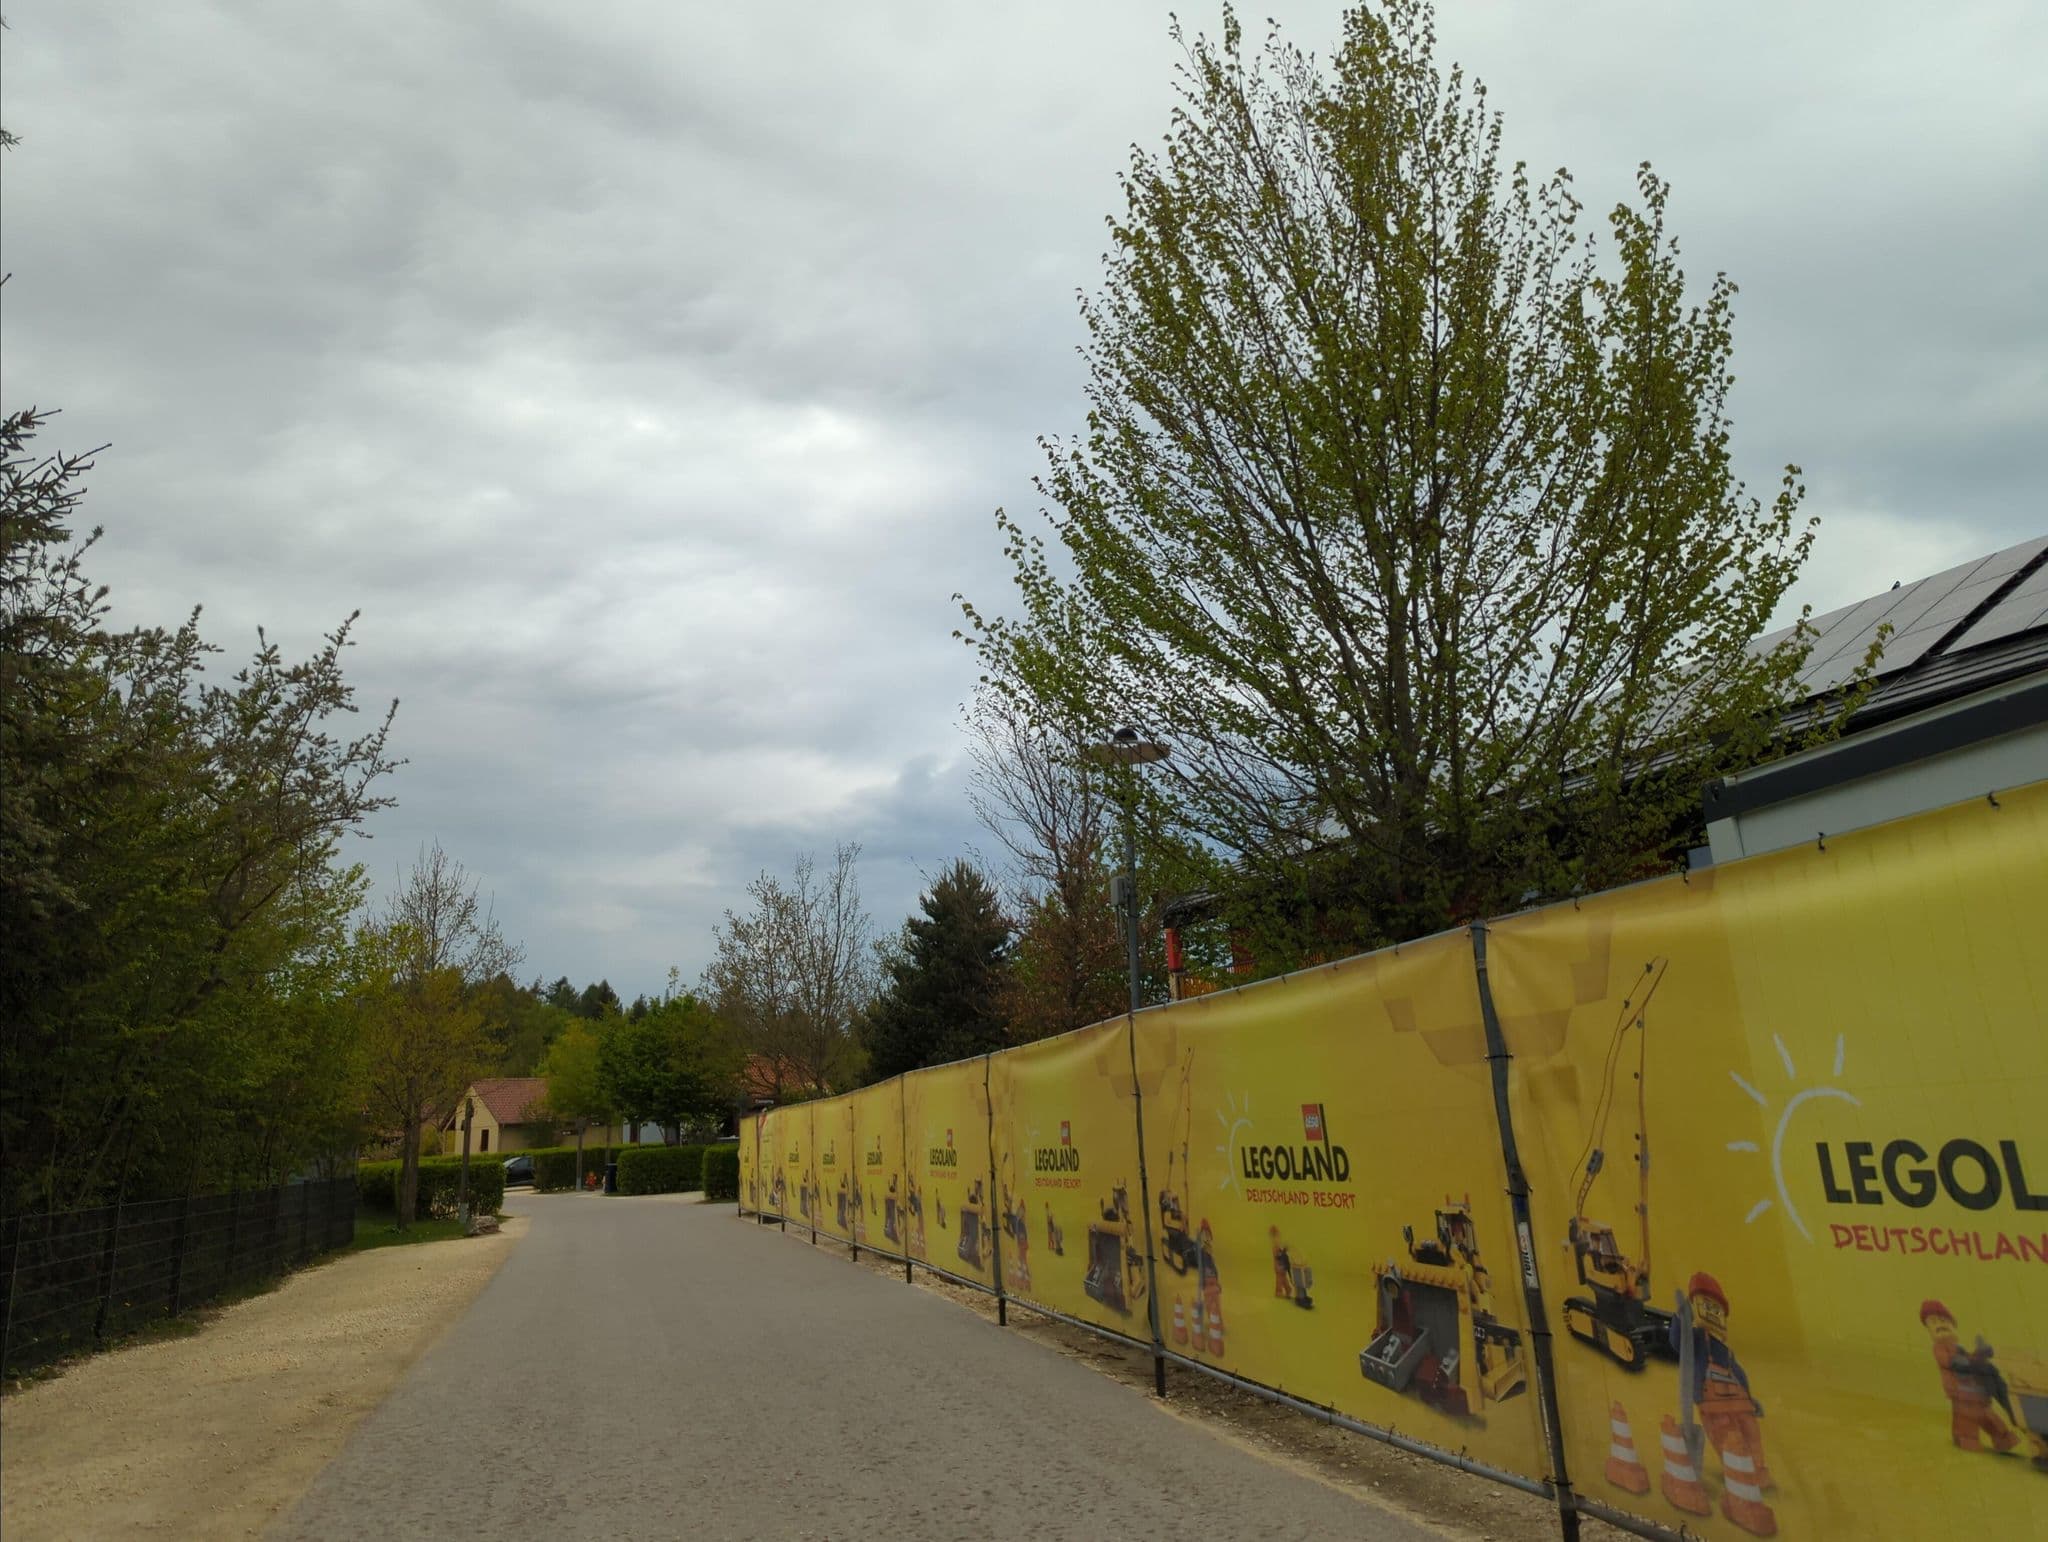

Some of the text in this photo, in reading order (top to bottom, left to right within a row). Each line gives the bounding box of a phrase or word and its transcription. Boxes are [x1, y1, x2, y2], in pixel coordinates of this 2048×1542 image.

[1034, 1146, 1080, 1172] LEGOLAND
[1241, 1143, 1350, 1182] LEGOLAND
[1816, 1138, 2048, 1211] LEGOL
[1246, 1188, 1356, 1208] DEUTSCHLAND RESORT
[1829, 1223, 2048, 1265] DEUTSCHLAN
